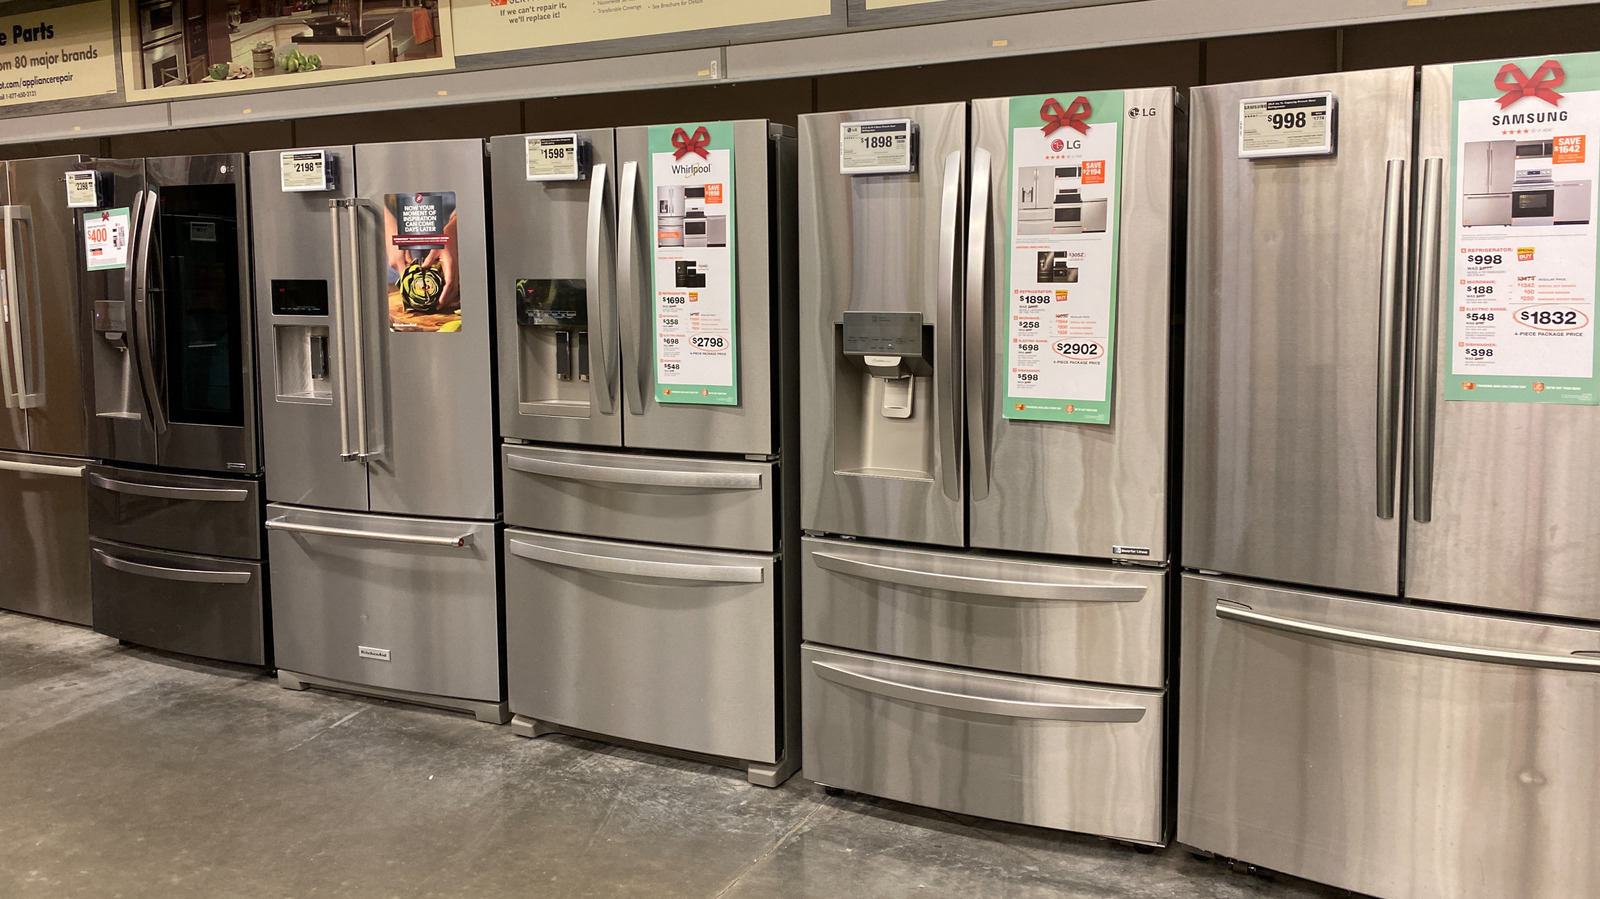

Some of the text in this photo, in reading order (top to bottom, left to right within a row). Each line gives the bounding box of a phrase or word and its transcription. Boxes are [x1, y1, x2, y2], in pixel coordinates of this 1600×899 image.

[518, 5, 536, 14] can't
[536, 3, 558, 14] repair
[559, 1, 568, 10] it,
[509, 11, 561, 25] we'll replace it!
[13, 22, 54, 44] Parts
[14, 55, 27, 69] 80
[30, 52, 59, 69] major
[61, 45, 98, 62] brands
[1142, 108, 1156, 116] LG
[1267, 112, 1307, 130] $998
[1491, 111, 1569, 126] SAMSUNG
[861, 136, 893, 148] $1898
[1066, 140, 1081, 149] LG
[1558, 137, 1581, 145] SAVE
[541, 148, 565, 159] $1598
[1554, 145, 1580, 154] $1642
[294, 162, 314, 173] $2198
[671, 164, 711, 176] Whirlpool
[87, 228, 107, 243] $400
[1467, 254, 1503, 265] $998
[1466, 286, 1494, 294] $188
[1019, 295, 1051, 304] $1898
[1466, 312, 1495, 321] $548
[1520, 311, 1577, 325] $1832
[692, 337, 723, 347] $2798
[1018, 343, 1039, 351] $698
[1056, 342, 1098, 355] $2902
[1465, 348, 1494, 356] $398
[1017, 373, 1039, 381] $598
